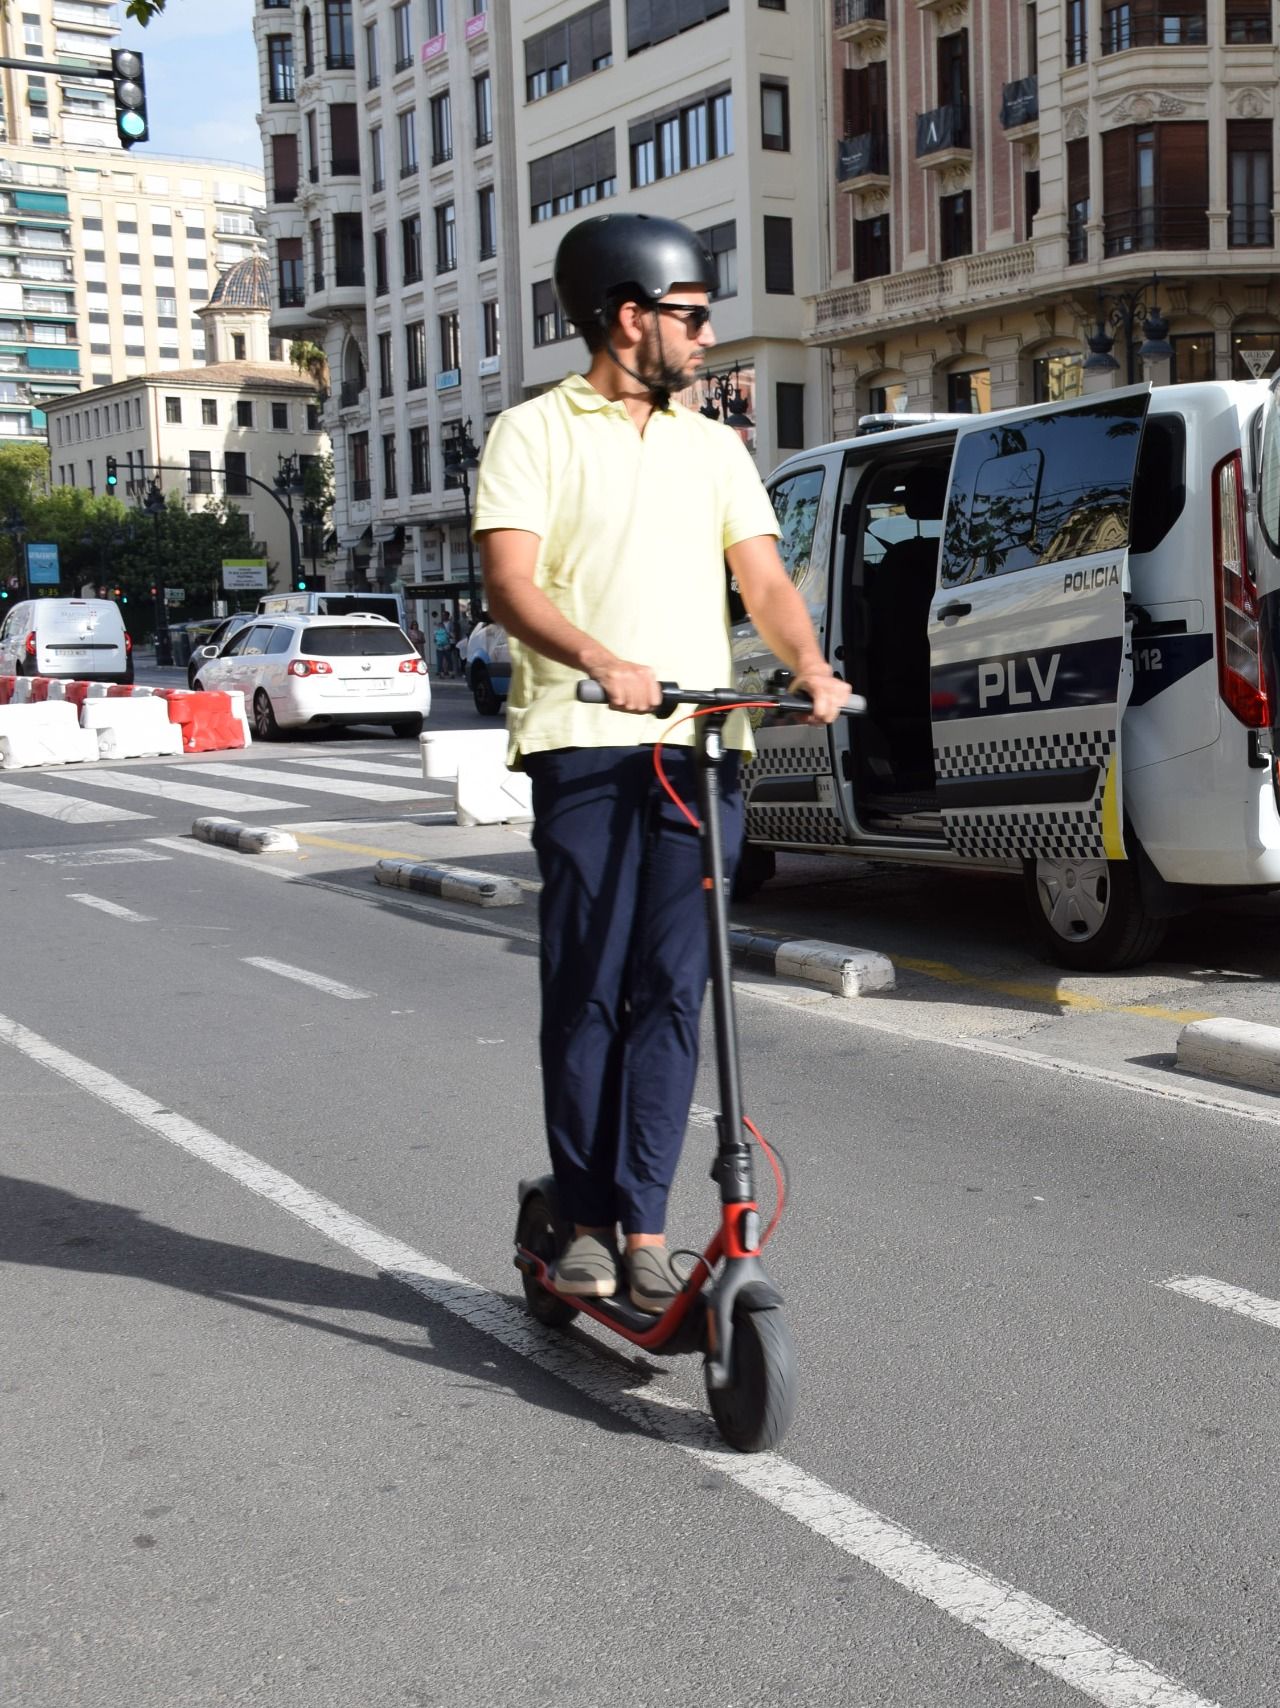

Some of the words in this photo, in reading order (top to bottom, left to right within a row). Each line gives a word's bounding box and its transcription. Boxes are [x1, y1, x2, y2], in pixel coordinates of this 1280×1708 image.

[1253, 363, 1261, 377] ?
[1064, 565, 1119, 593] POLICIA
[1133, 648, 1162, 671] 112
[978, 653, 1061, 708] PLV
